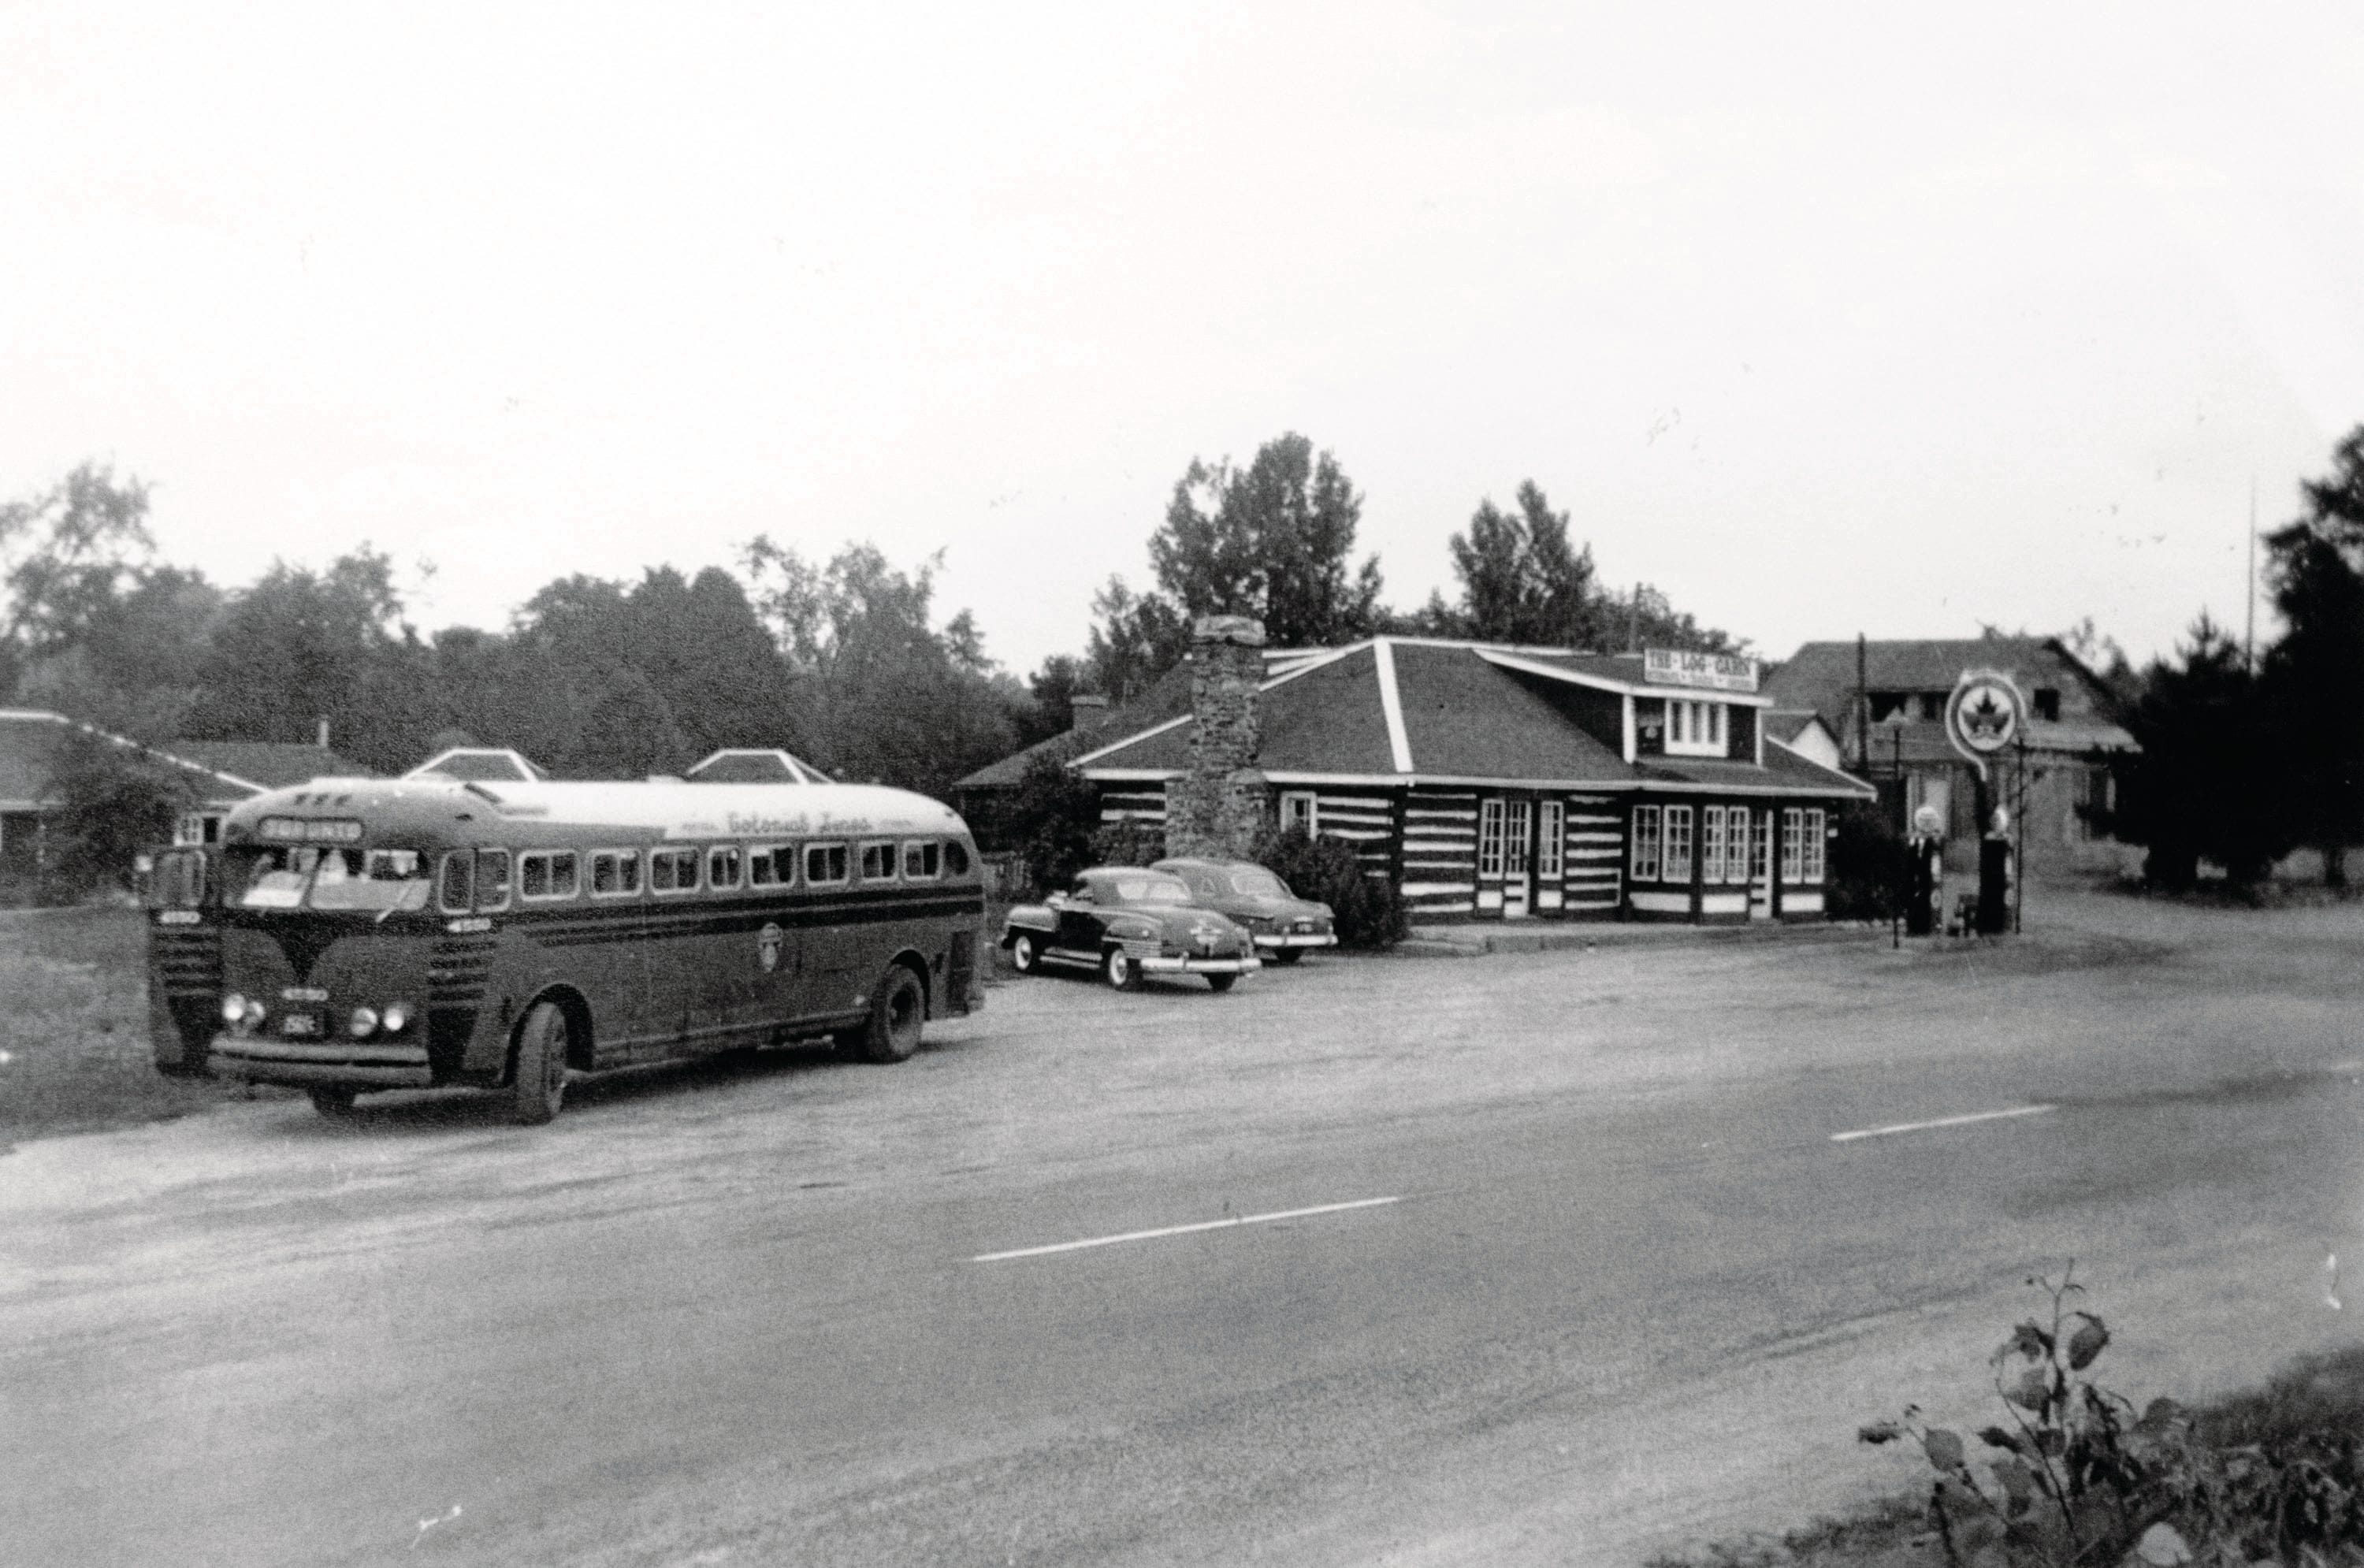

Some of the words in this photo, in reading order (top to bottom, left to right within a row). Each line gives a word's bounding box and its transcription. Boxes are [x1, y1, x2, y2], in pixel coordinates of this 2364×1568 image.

[1650, 652, 1671, 669] THE
[1681, 653, 1706, 672] LOG
[1715, 656, 1751, 676] CABIN
